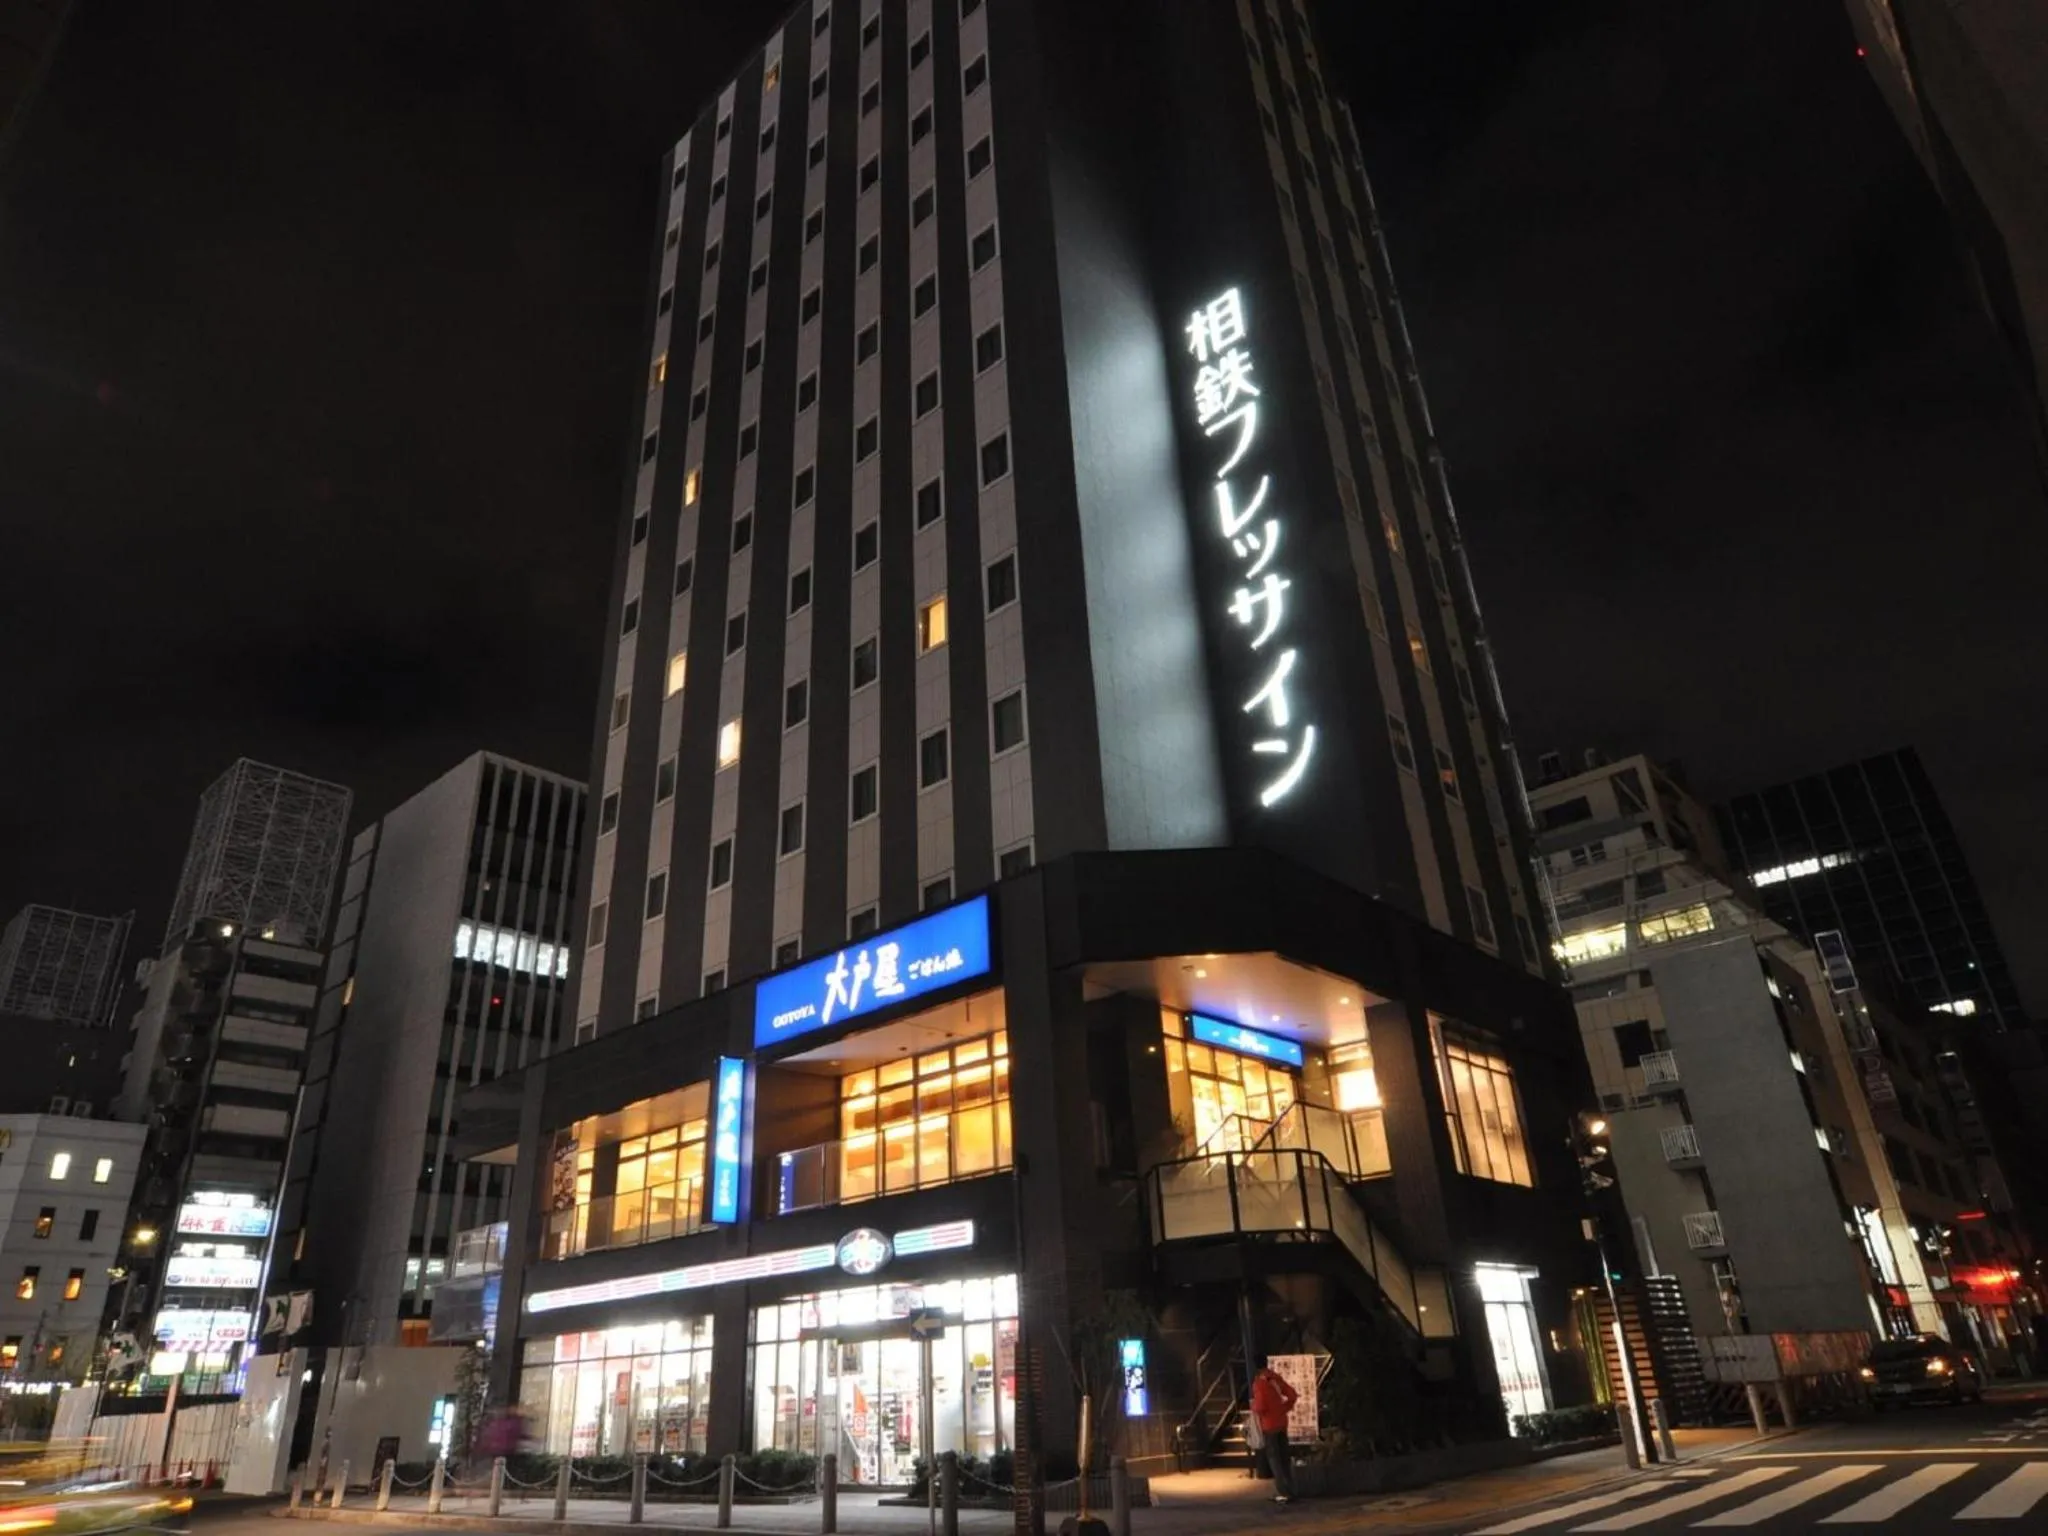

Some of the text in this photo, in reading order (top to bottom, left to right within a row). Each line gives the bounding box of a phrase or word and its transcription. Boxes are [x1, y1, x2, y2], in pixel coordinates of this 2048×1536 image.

[1185, 287, 1316, 806] 相鉄フレッサイン
